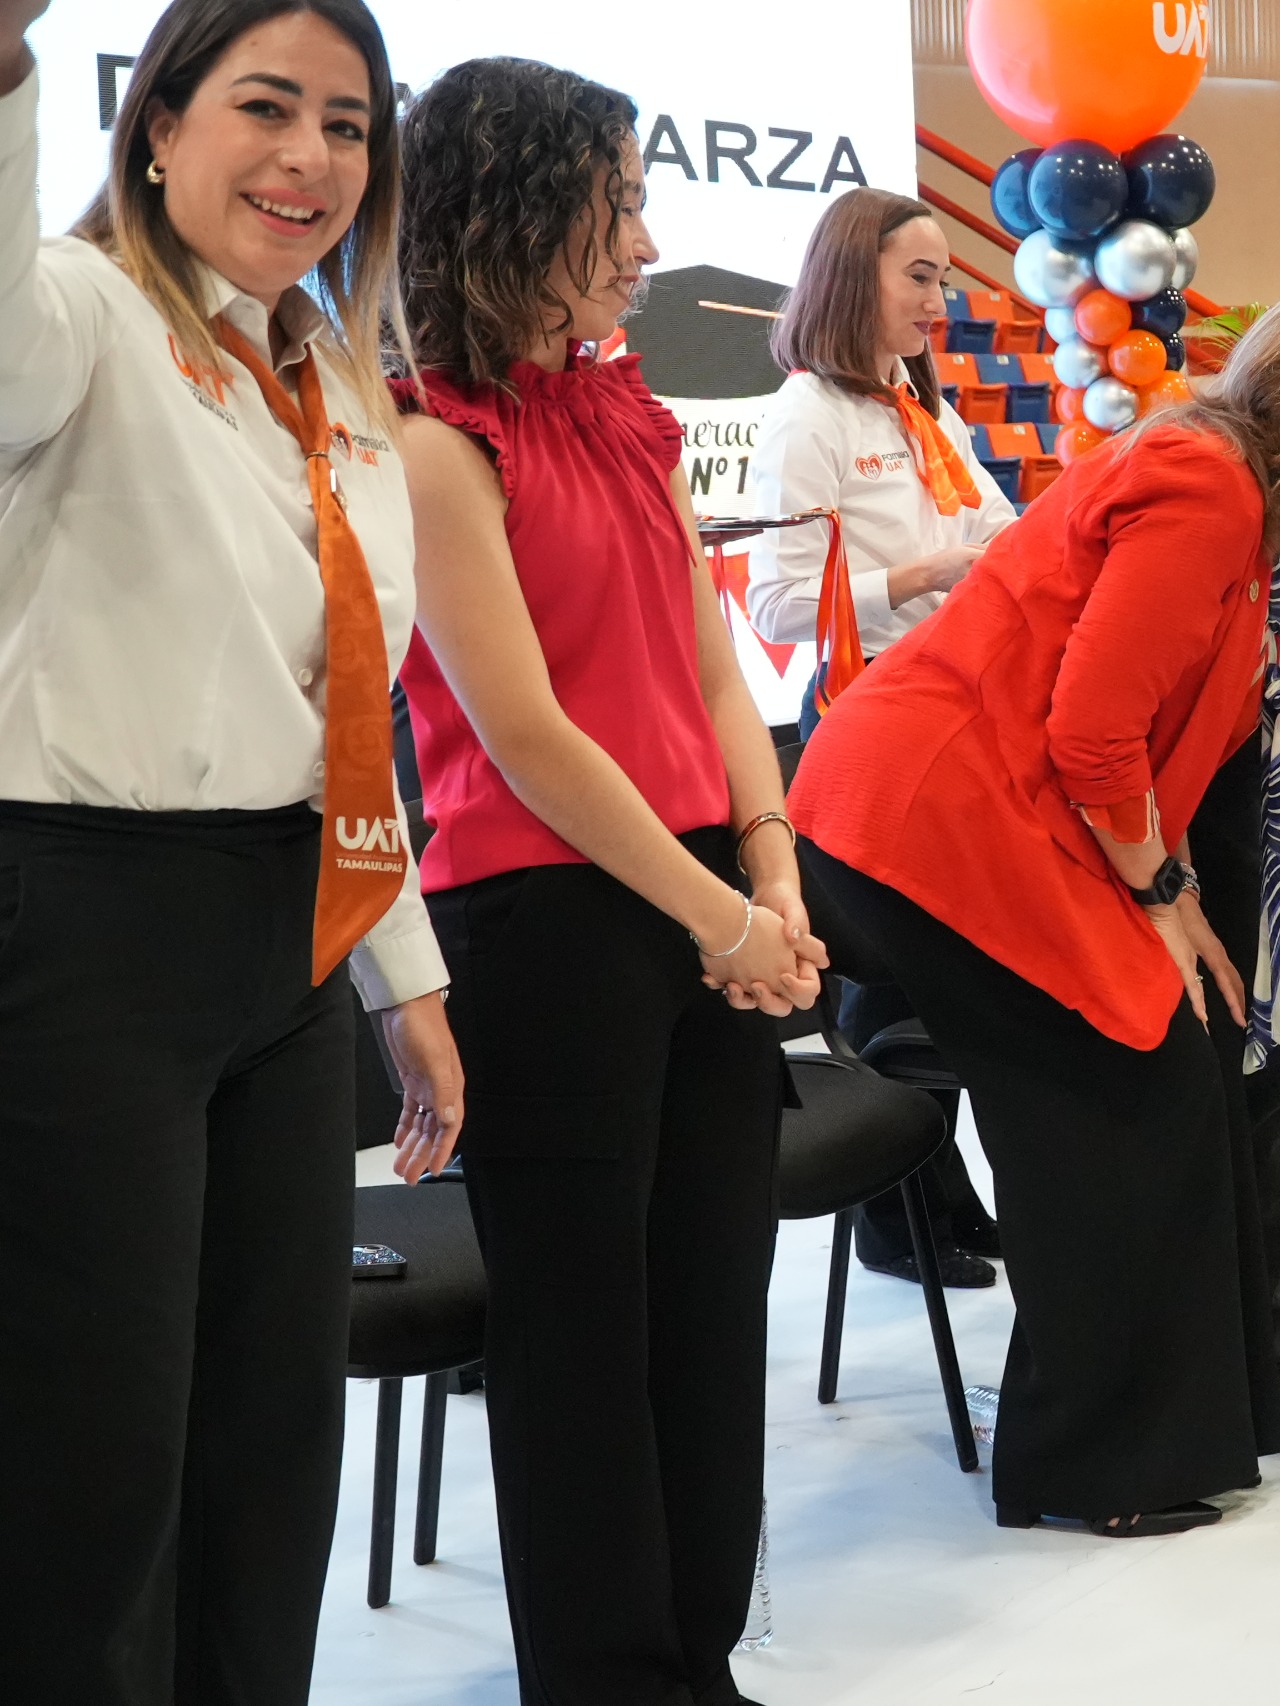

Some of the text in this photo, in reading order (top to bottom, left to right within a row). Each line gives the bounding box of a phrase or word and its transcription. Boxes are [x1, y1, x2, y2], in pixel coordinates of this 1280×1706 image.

[1152, 1, 1209, 58] UAT
[736, 455, 749, 495] 1
[885, 460, 904, 472] UAT
[335, 816, 400, 854] UAT
[335, 858, 403, 874] TAMAULIPAS
